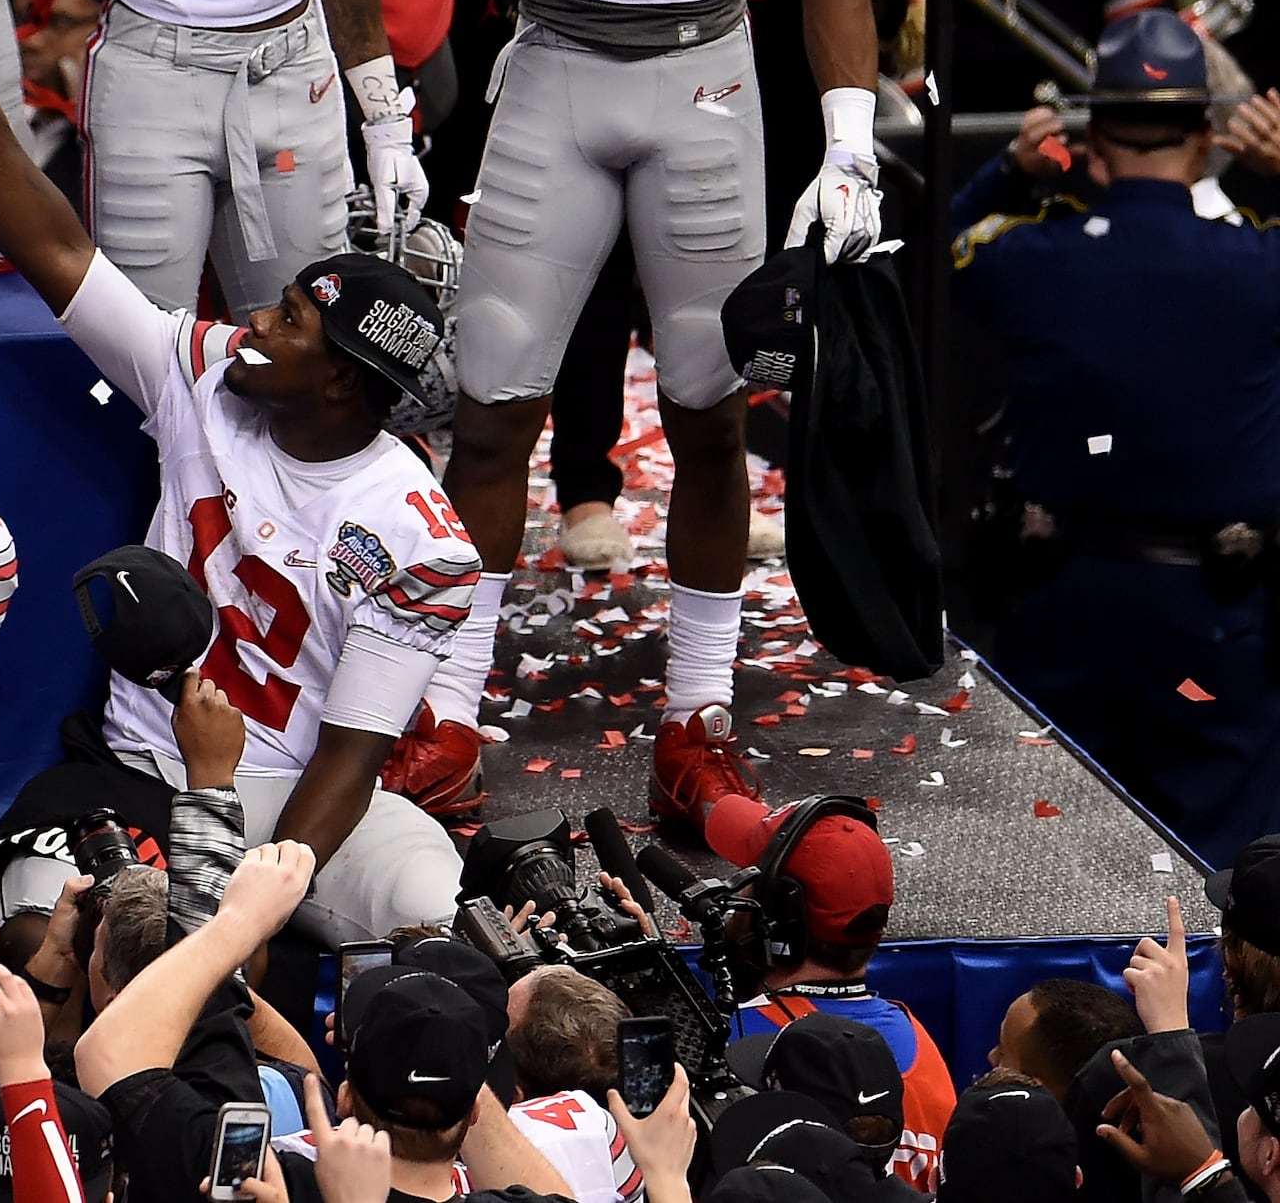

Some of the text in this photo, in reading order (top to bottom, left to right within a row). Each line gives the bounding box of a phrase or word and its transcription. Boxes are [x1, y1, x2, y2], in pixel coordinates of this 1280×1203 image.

[369, 299, 419, 340] SUGAR
[342, 534, 382, 572] Allstate
[188, 494, 312, 733] 12
